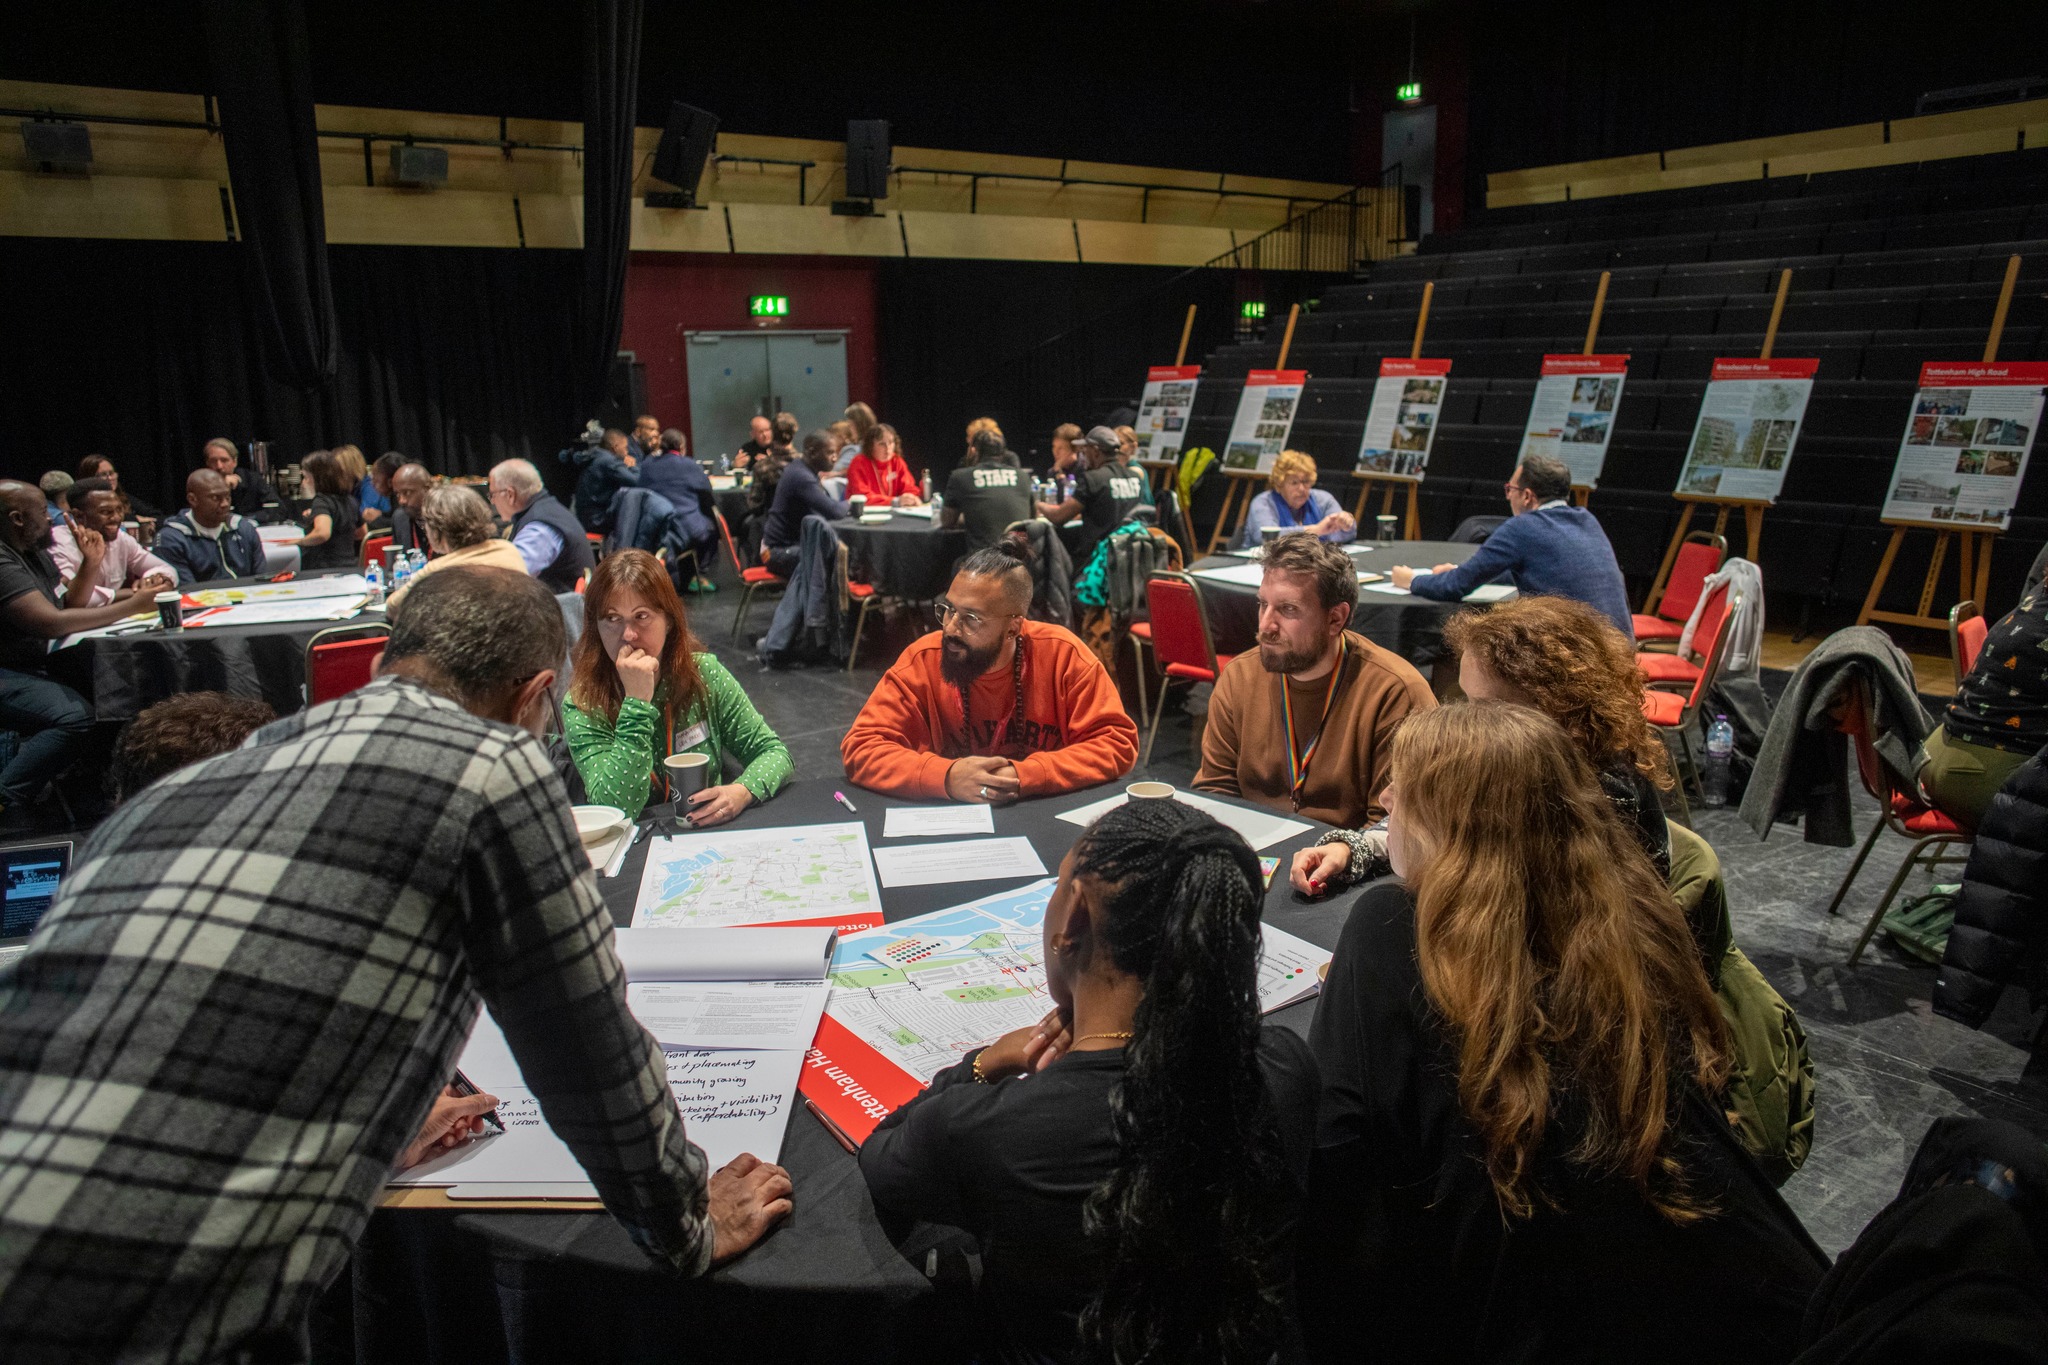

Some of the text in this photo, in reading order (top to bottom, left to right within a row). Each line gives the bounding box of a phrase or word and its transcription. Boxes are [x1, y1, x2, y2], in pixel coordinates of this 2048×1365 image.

[1753, 363, 1770, 371] Farm
[1926, 368, 2009, 377] Tottenham High Road
[974, 469, 1017, 487] STAFF
[1109, 477, 1141, 499] STAFF
[838, 923, 873, 931] Totte
[806, 1046, 890, 1122] ttenham Ha
[729, 1094, 783, 1107] visibility
